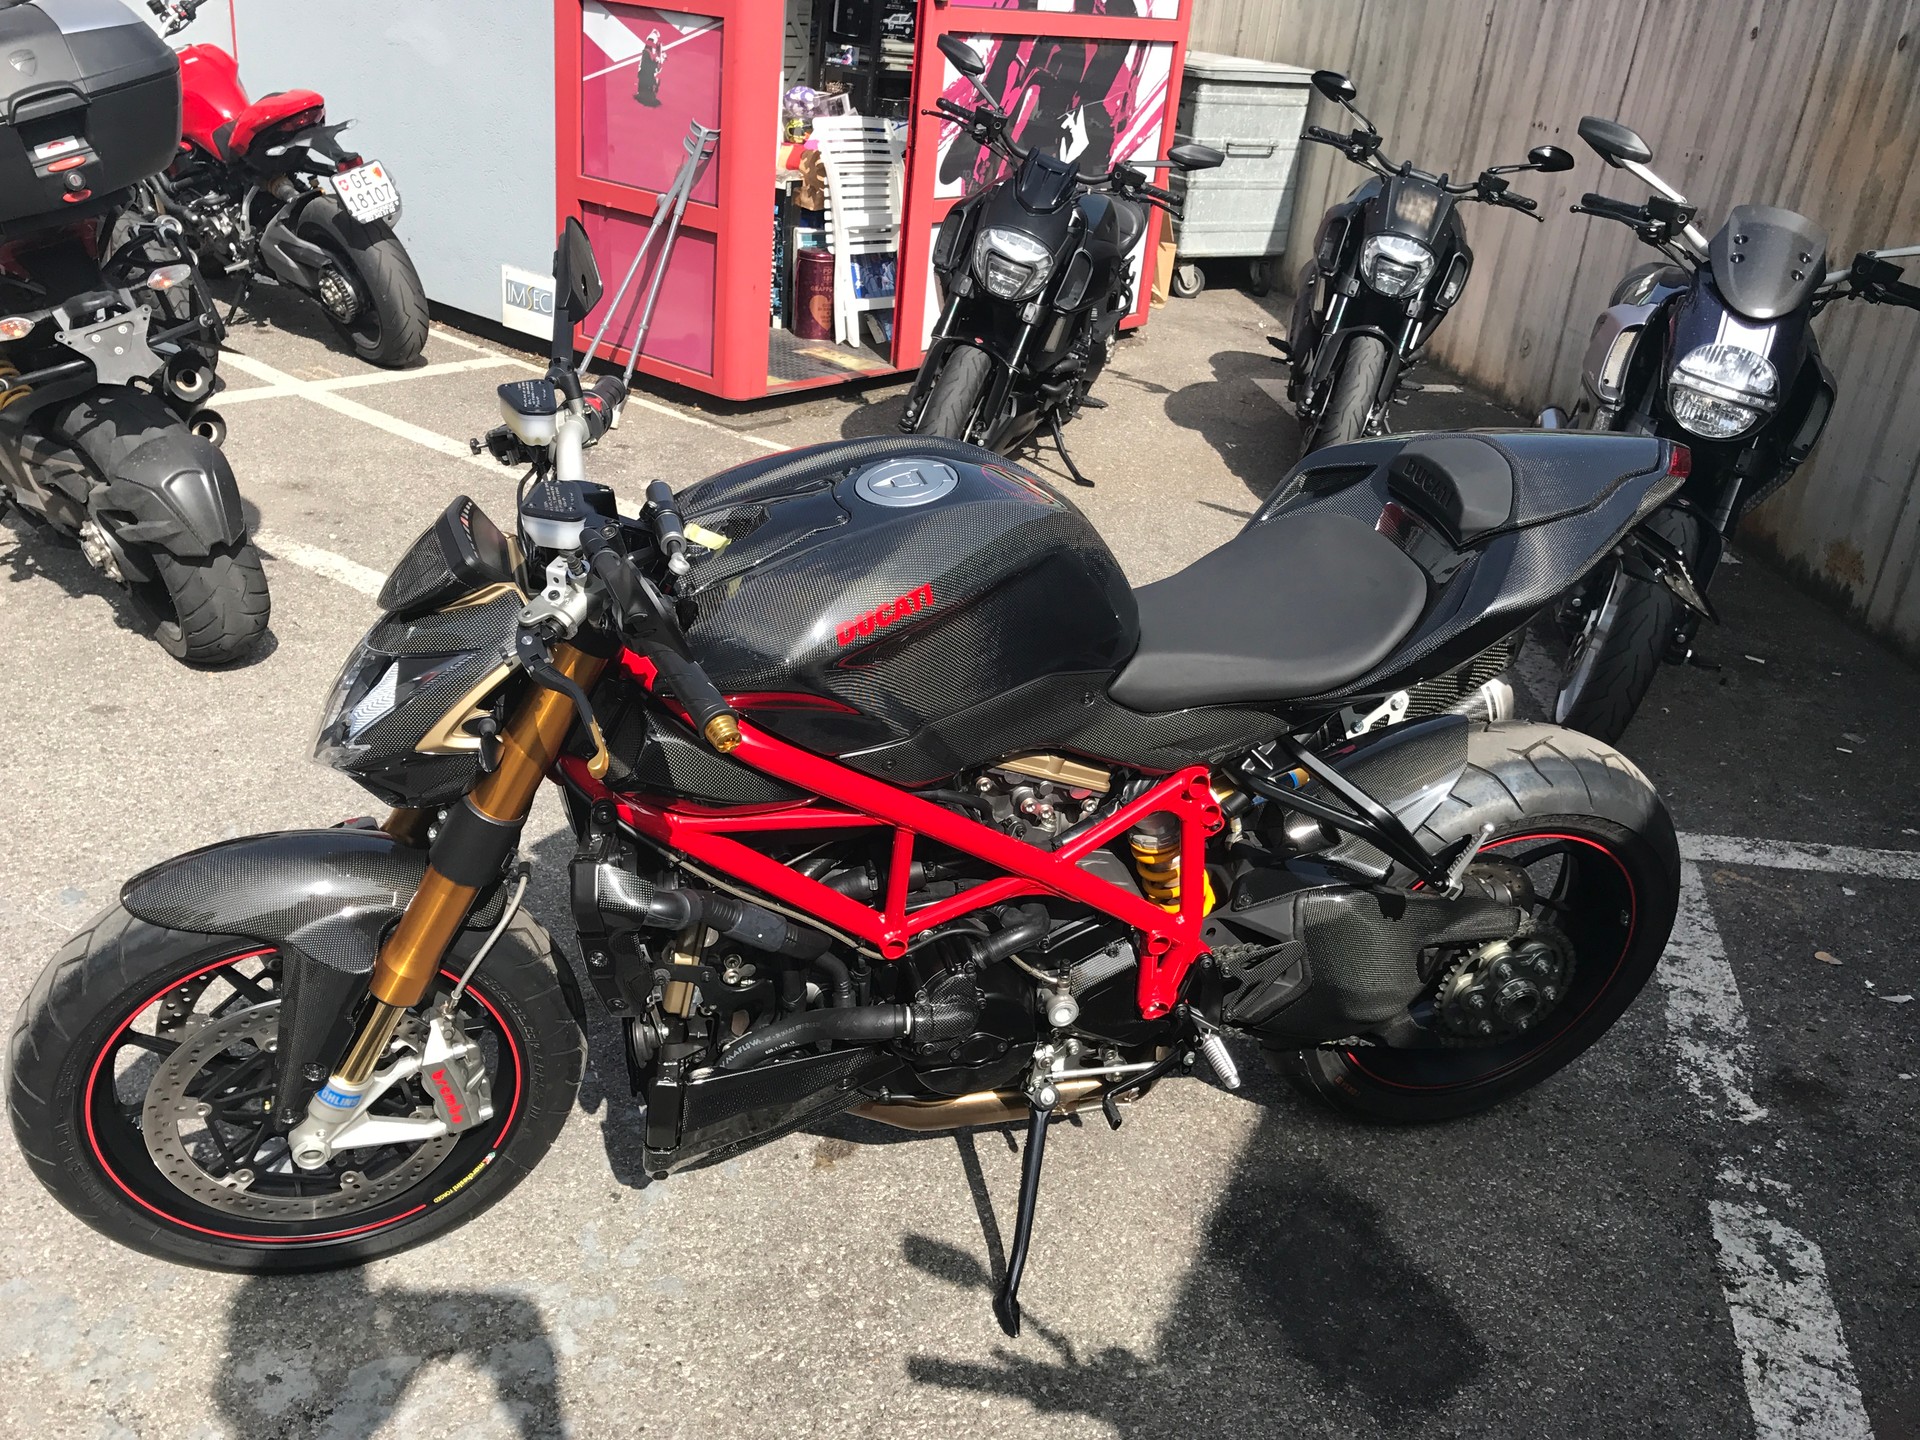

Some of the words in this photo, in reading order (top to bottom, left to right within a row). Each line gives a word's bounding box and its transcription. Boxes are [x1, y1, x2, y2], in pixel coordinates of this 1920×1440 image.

[350, 169, 373, 189] GE
[349, 182, 392, 212] 18107
[507, 282, 552, 313] IMSEC
[834, 582, 934, 647] DUCATI
[432, 1069, 463, 1124] brembo
[452, 1162, 485, 1193] marchesini
[433, 1187, 455, 1204] FORGED
